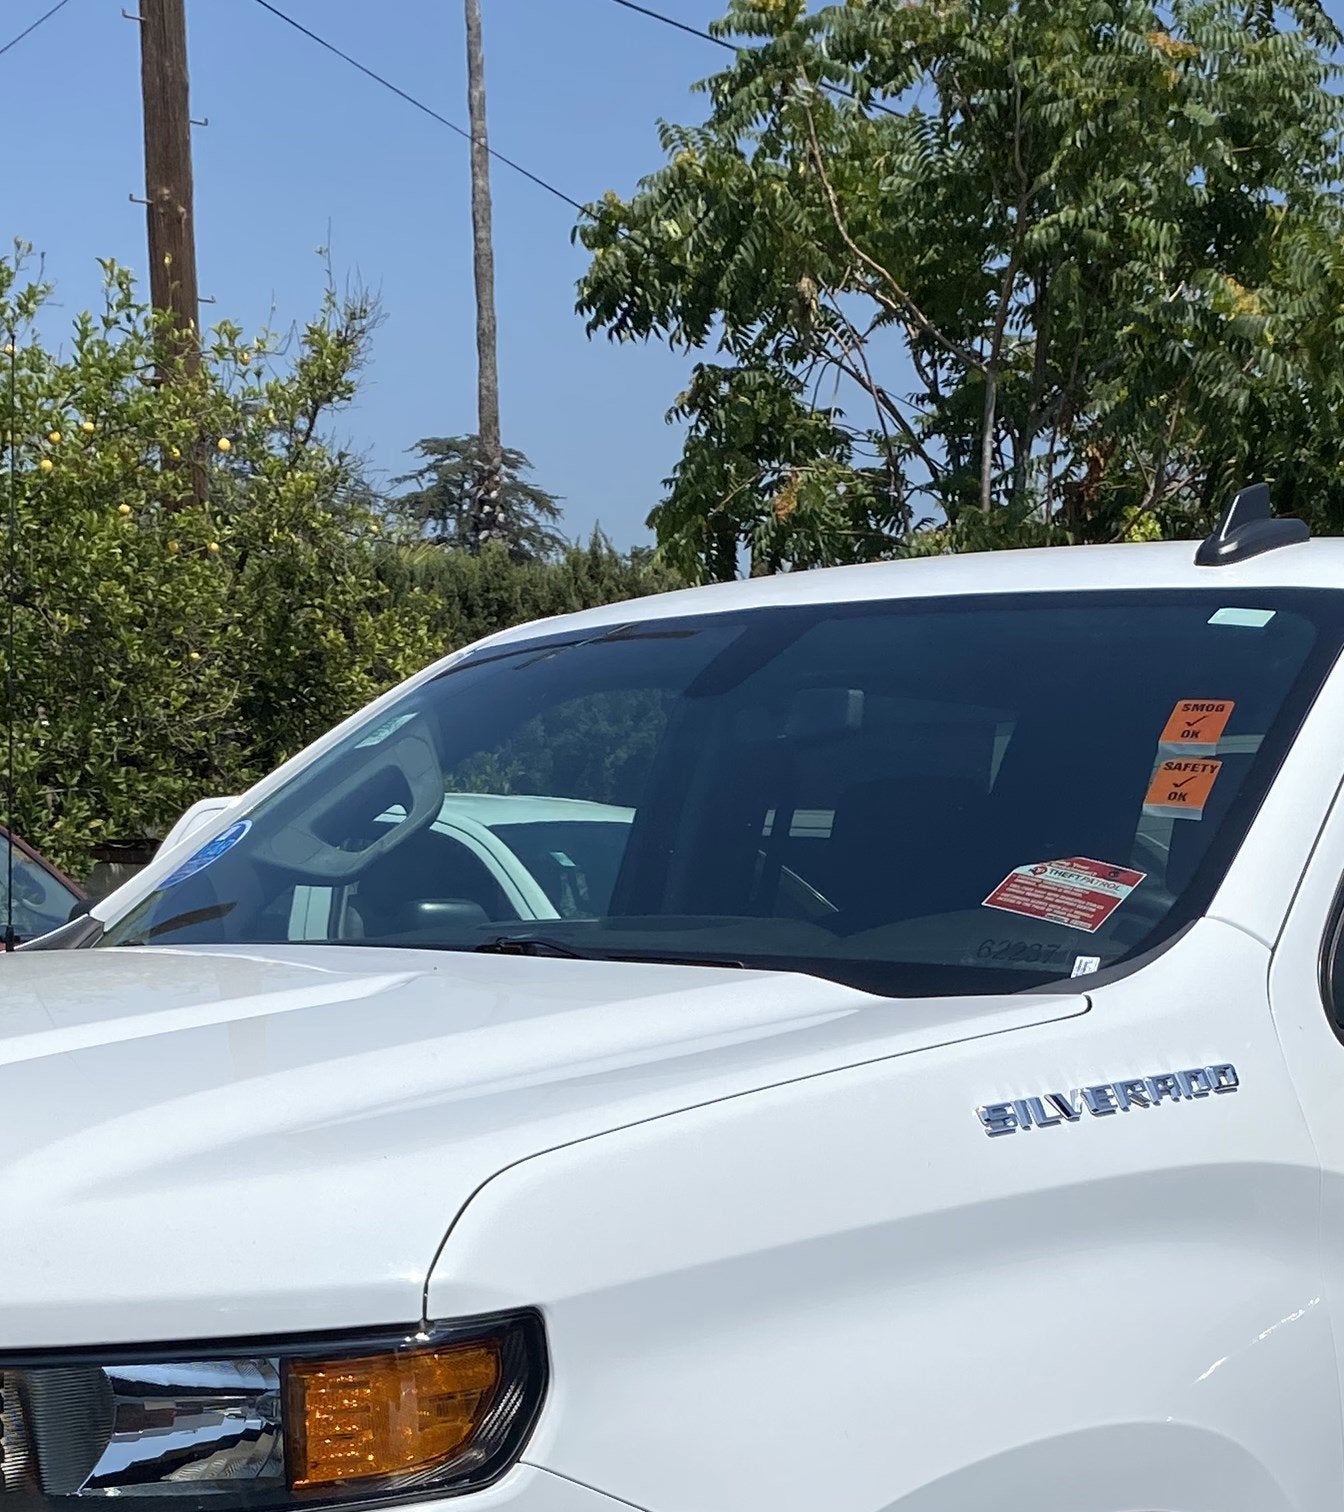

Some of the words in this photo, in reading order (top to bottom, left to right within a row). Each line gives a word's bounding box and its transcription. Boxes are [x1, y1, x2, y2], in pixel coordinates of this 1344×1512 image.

[1181, 703, 1226, 713] SMOG
[1180, 729, 1201, 739] OK
[1163, 761, 1219, 774] SAFETY
[1167, 791, 1189, 802] OK
[975, 1063, 1240, 1138] SILVERADO
